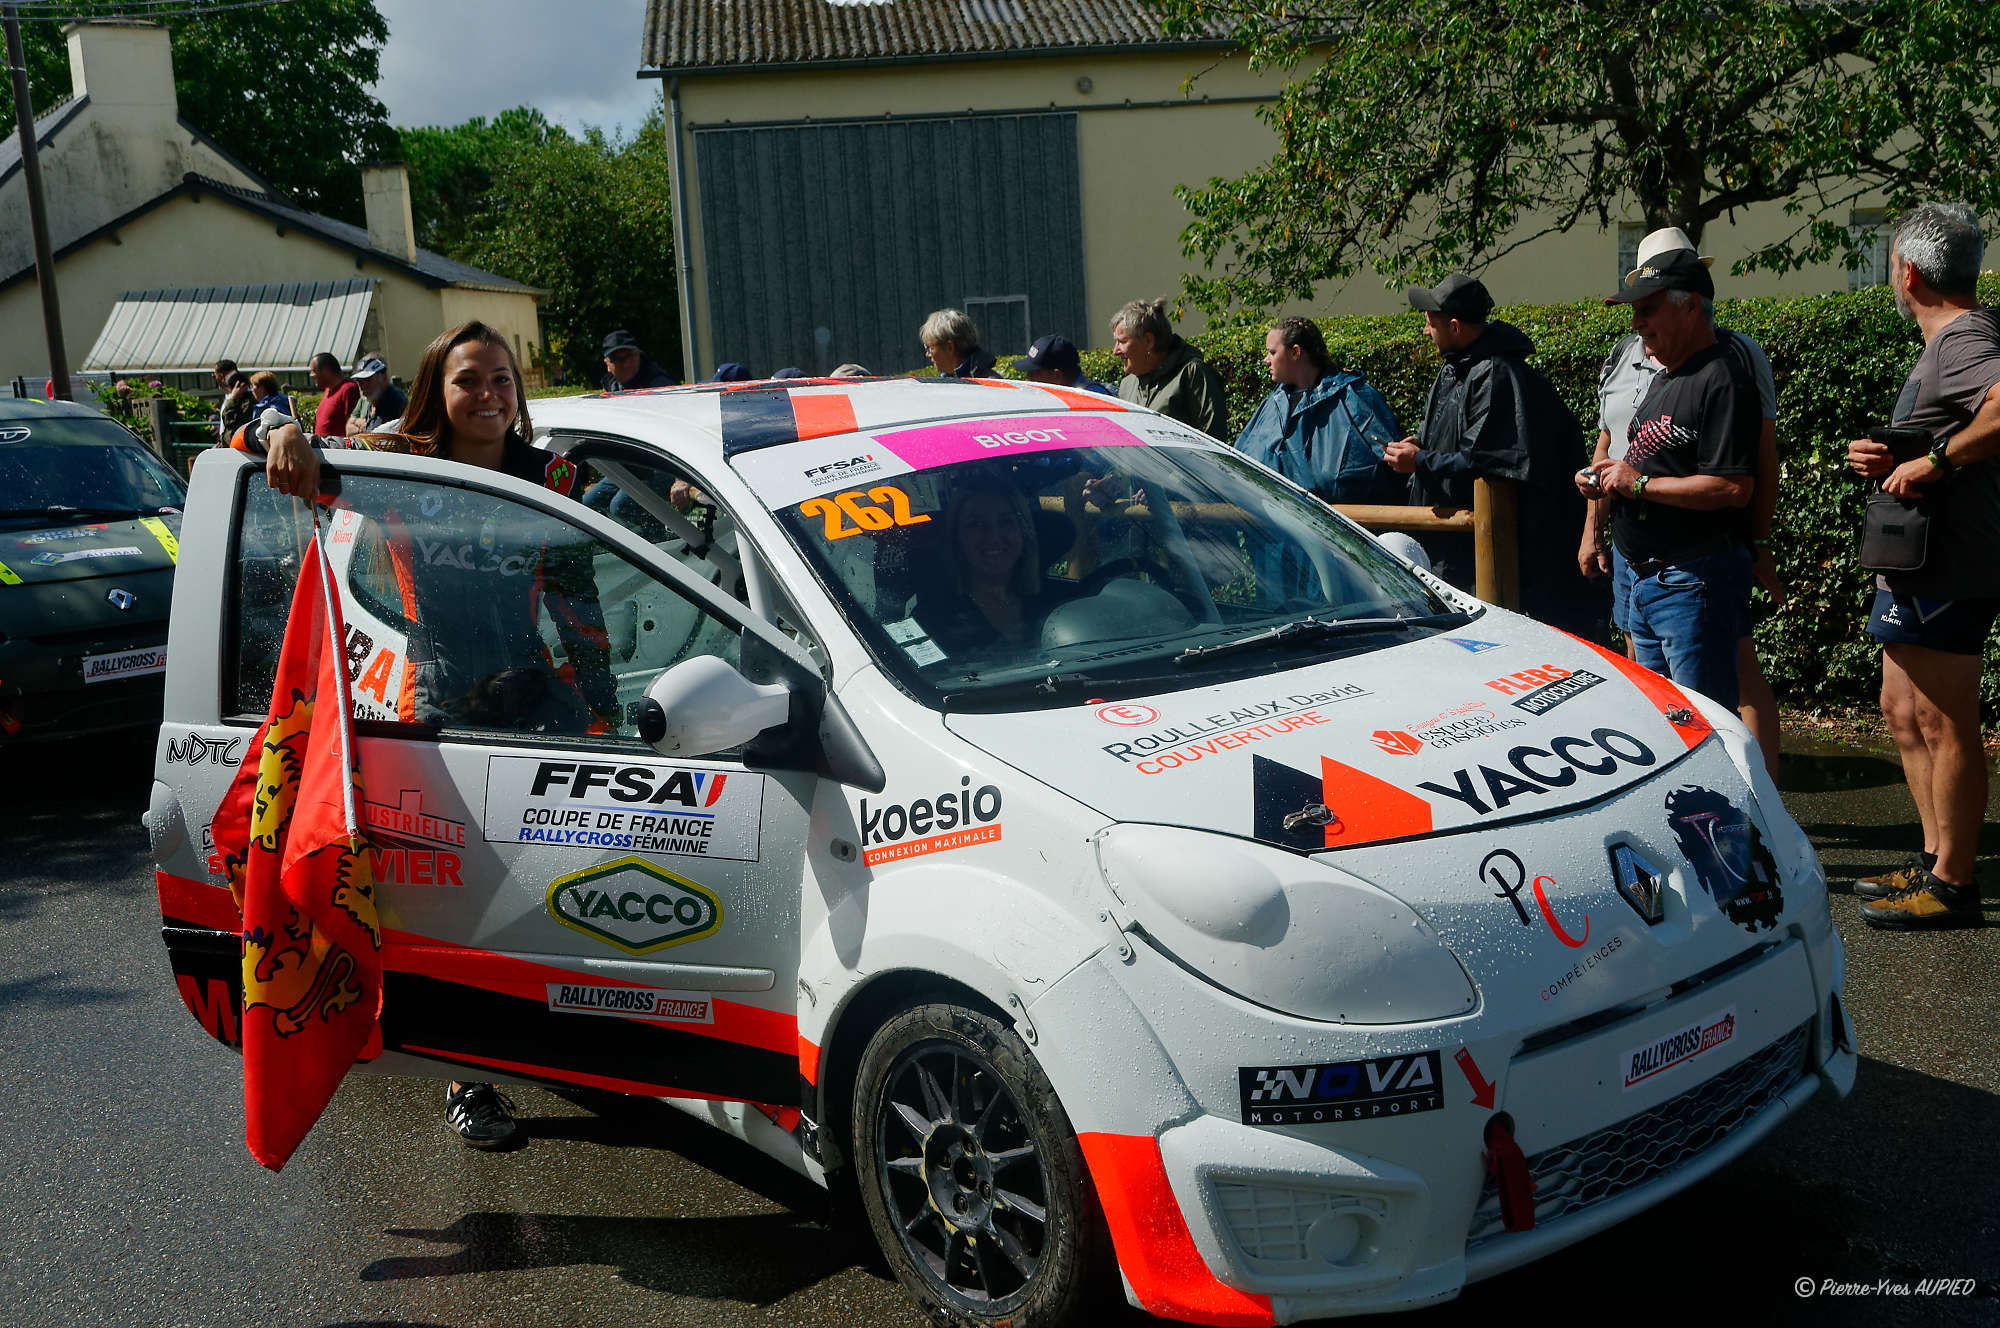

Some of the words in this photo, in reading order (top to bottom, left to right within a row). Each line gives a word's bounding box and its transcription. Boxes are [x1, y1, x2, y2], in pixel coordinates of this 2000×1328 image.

[973, 428, 1068, 449] BIGOT
[803, 456, 867, 479] FFSA
[800, 485, 933, 541] 262
[1880, 614, 1902, 626] KUKRI
[91, 651, 157, 676] RALLYCROSS
[1484, 663, 1574, 696] FLERS
[1519, 671, 1600, 714] MOTOCULTURE
[1101, 699, 1290, 764] ROULLEAUX
[1287, 683, 1365, 706] David
[1417, 713, 1491, 742] espace
[1135, 711, 1332, 775] COUVERTURE
[530, 762, 698, 808] FFSA
[1416, 728, 1657, 815] YACCO
[368, 804, 466, 845] USTRIELLE
[522, 808, 592, 829] COUPE
[596, 812, 625, 830] DE
[629, 815, 715, 838] FRANCE
[860, 775, 1002, 846] koesio
[868, 842, 928, 863] CONNEXION
[935, 829, 996, 849] MAXIMALE
[368, 849, 464, 886] VIER
[568, 888, 702, 926] YACCO
[1541, 936, 1623, 1001] COMPÉTENCES
[559, 985, 655, 1011] RALLYCROSS
[658, 1001, 705, 1018] FRANCE
[1630, 1025, 1701, 1079] RALLYCROSS
[1703, 1021, 1731, 1050] FRANCE
[1270, 1056, 1435, 1100] NOVA
[1251, 1097, 1436, 1124] MOTORSPORT
